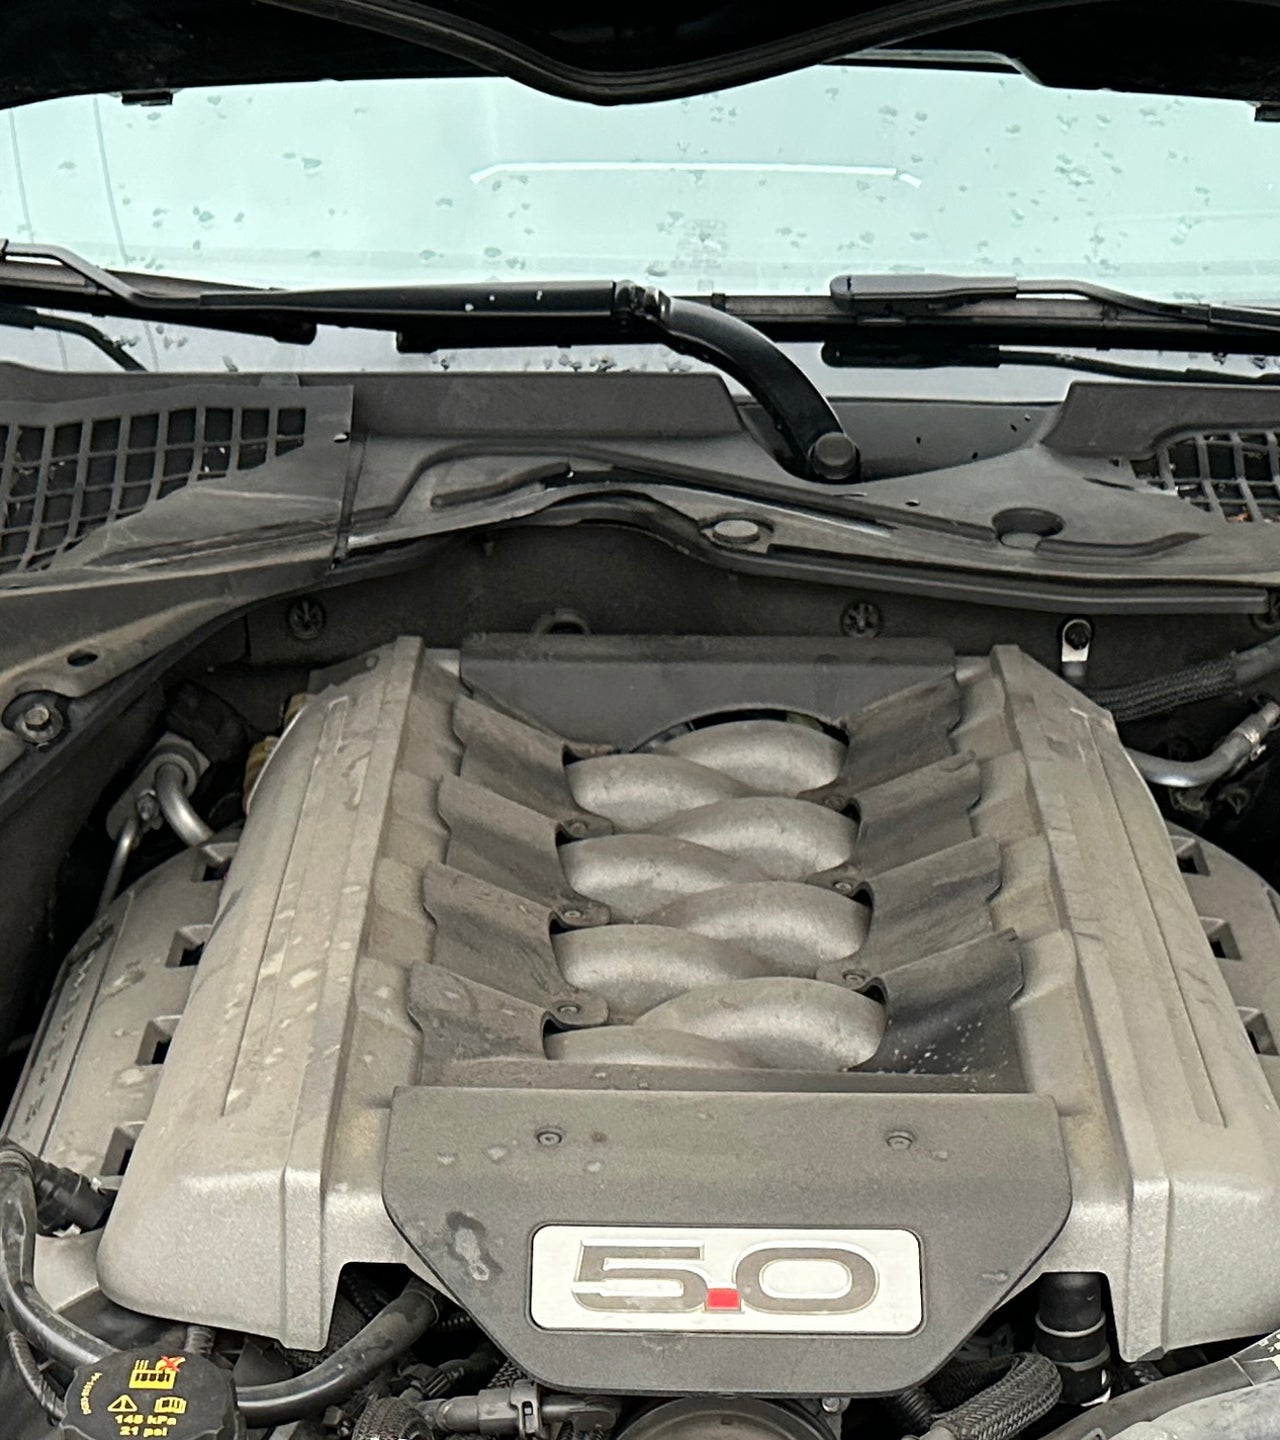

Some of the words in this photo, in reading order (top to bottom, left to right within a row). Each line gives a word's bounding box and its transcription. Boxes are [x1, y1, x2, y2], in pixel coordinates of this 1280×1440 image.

[572, 1239, 879, 1315] 5.0
[147, 1415, 177, 1425] kPa
[120, 1426, 139, 1435] 21
